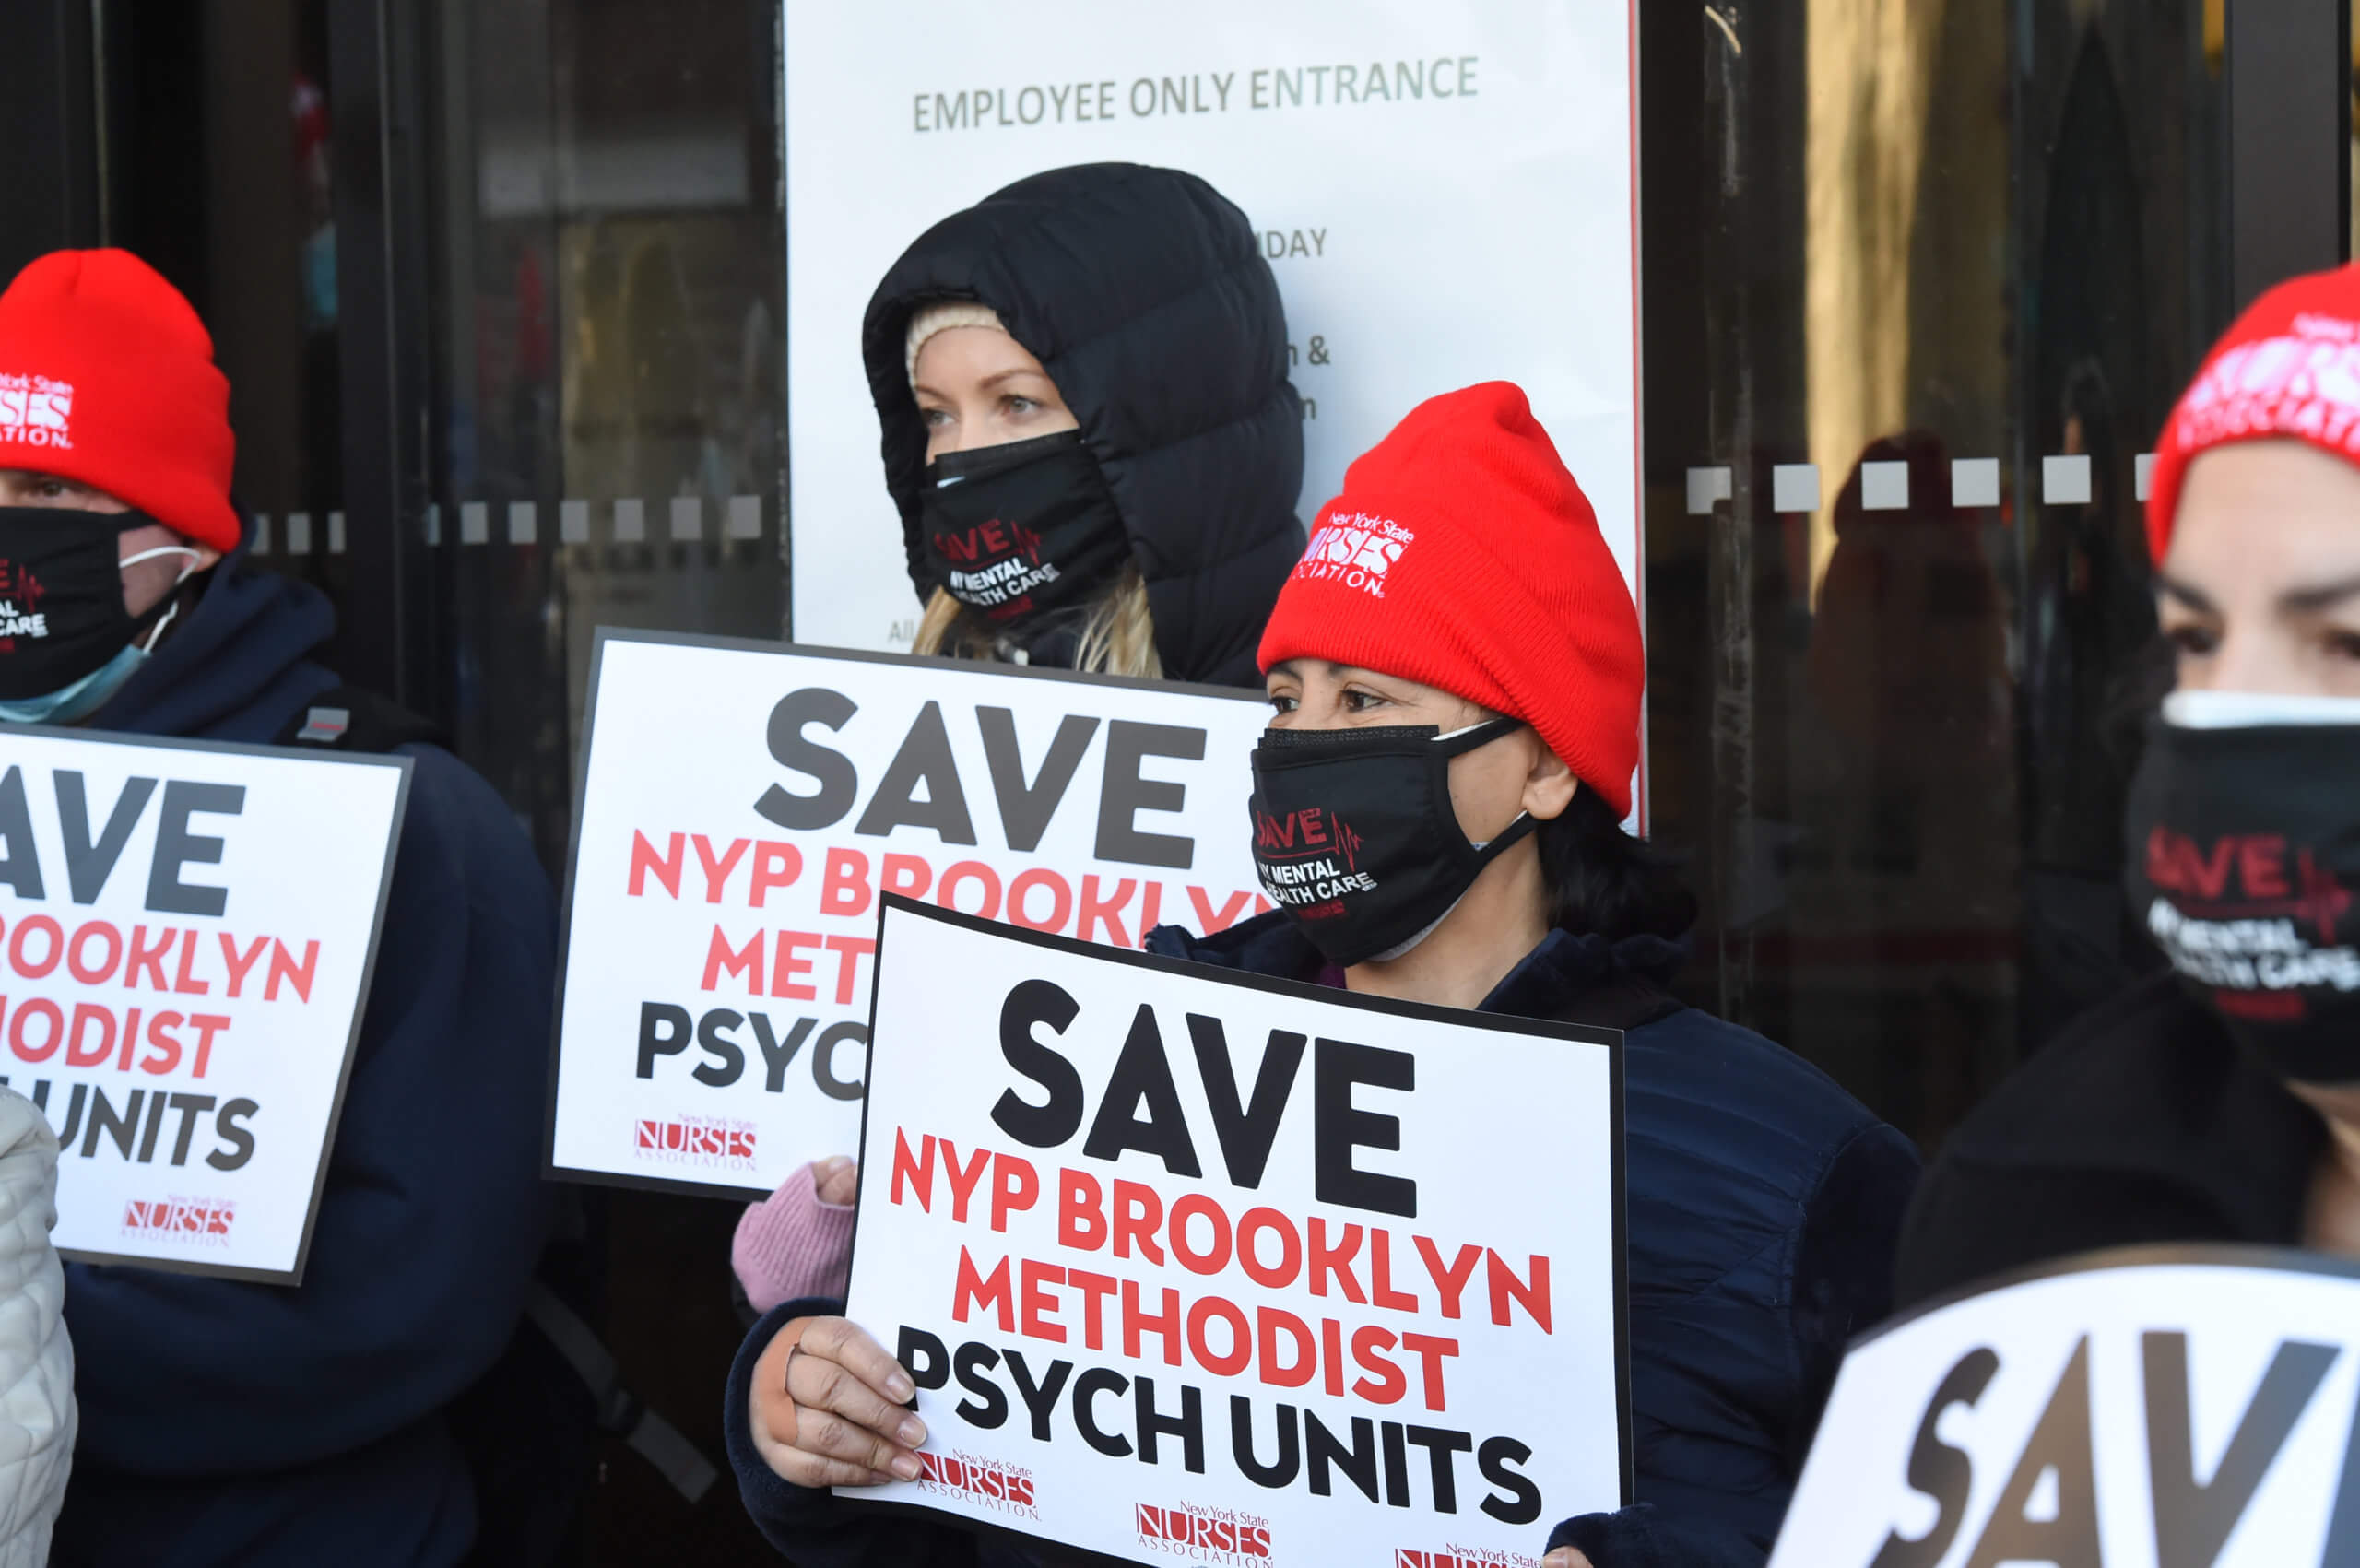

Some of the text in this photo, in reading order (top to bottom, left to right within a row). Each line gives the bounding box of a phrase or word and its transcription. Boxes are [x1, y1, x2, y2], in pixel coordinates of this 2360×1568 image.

[914, 56, 1479, 133] EMPLOYEE ONLY ENTRANCE
[1351, 512, 1381, 532] York
[1379, 519, 1415, 544] State
[752, 687, 1208, 869] SAVE
[627, 828, 803, 908] NYP
[1270, 858, 1340, 884] MENTAL
[1316, 872, 1374, 899] CARE
[0, 914, 321, 1004] OOKLYN
[0, 996, 231, 1079] ODIST
[989, 978, 1418, 1219] SAVE
[634, 1119, 757, 1159] NURSES
[122, 1199, 235, 1234] NURSES
[889, 1125, 1552, 1335] NYP BROOKLYN
[951, 1244, 1459, 1411] METHODIST
[897, 1325, 1542, 1525] PSYCH UNITS
[914, 1450, 1037, 1508] NURSES
[952, 1447, 1032, 1479] New York State
[1135, 1502, 1272, 1560] NURSES
[1180, 1499, 1269, 1527] New York State
[1138, 1534, 1274, 1568] ASSOCIATION
[1446, 1542, 1478, 1558] New
[1478, 1547, 1509, 1564] York
